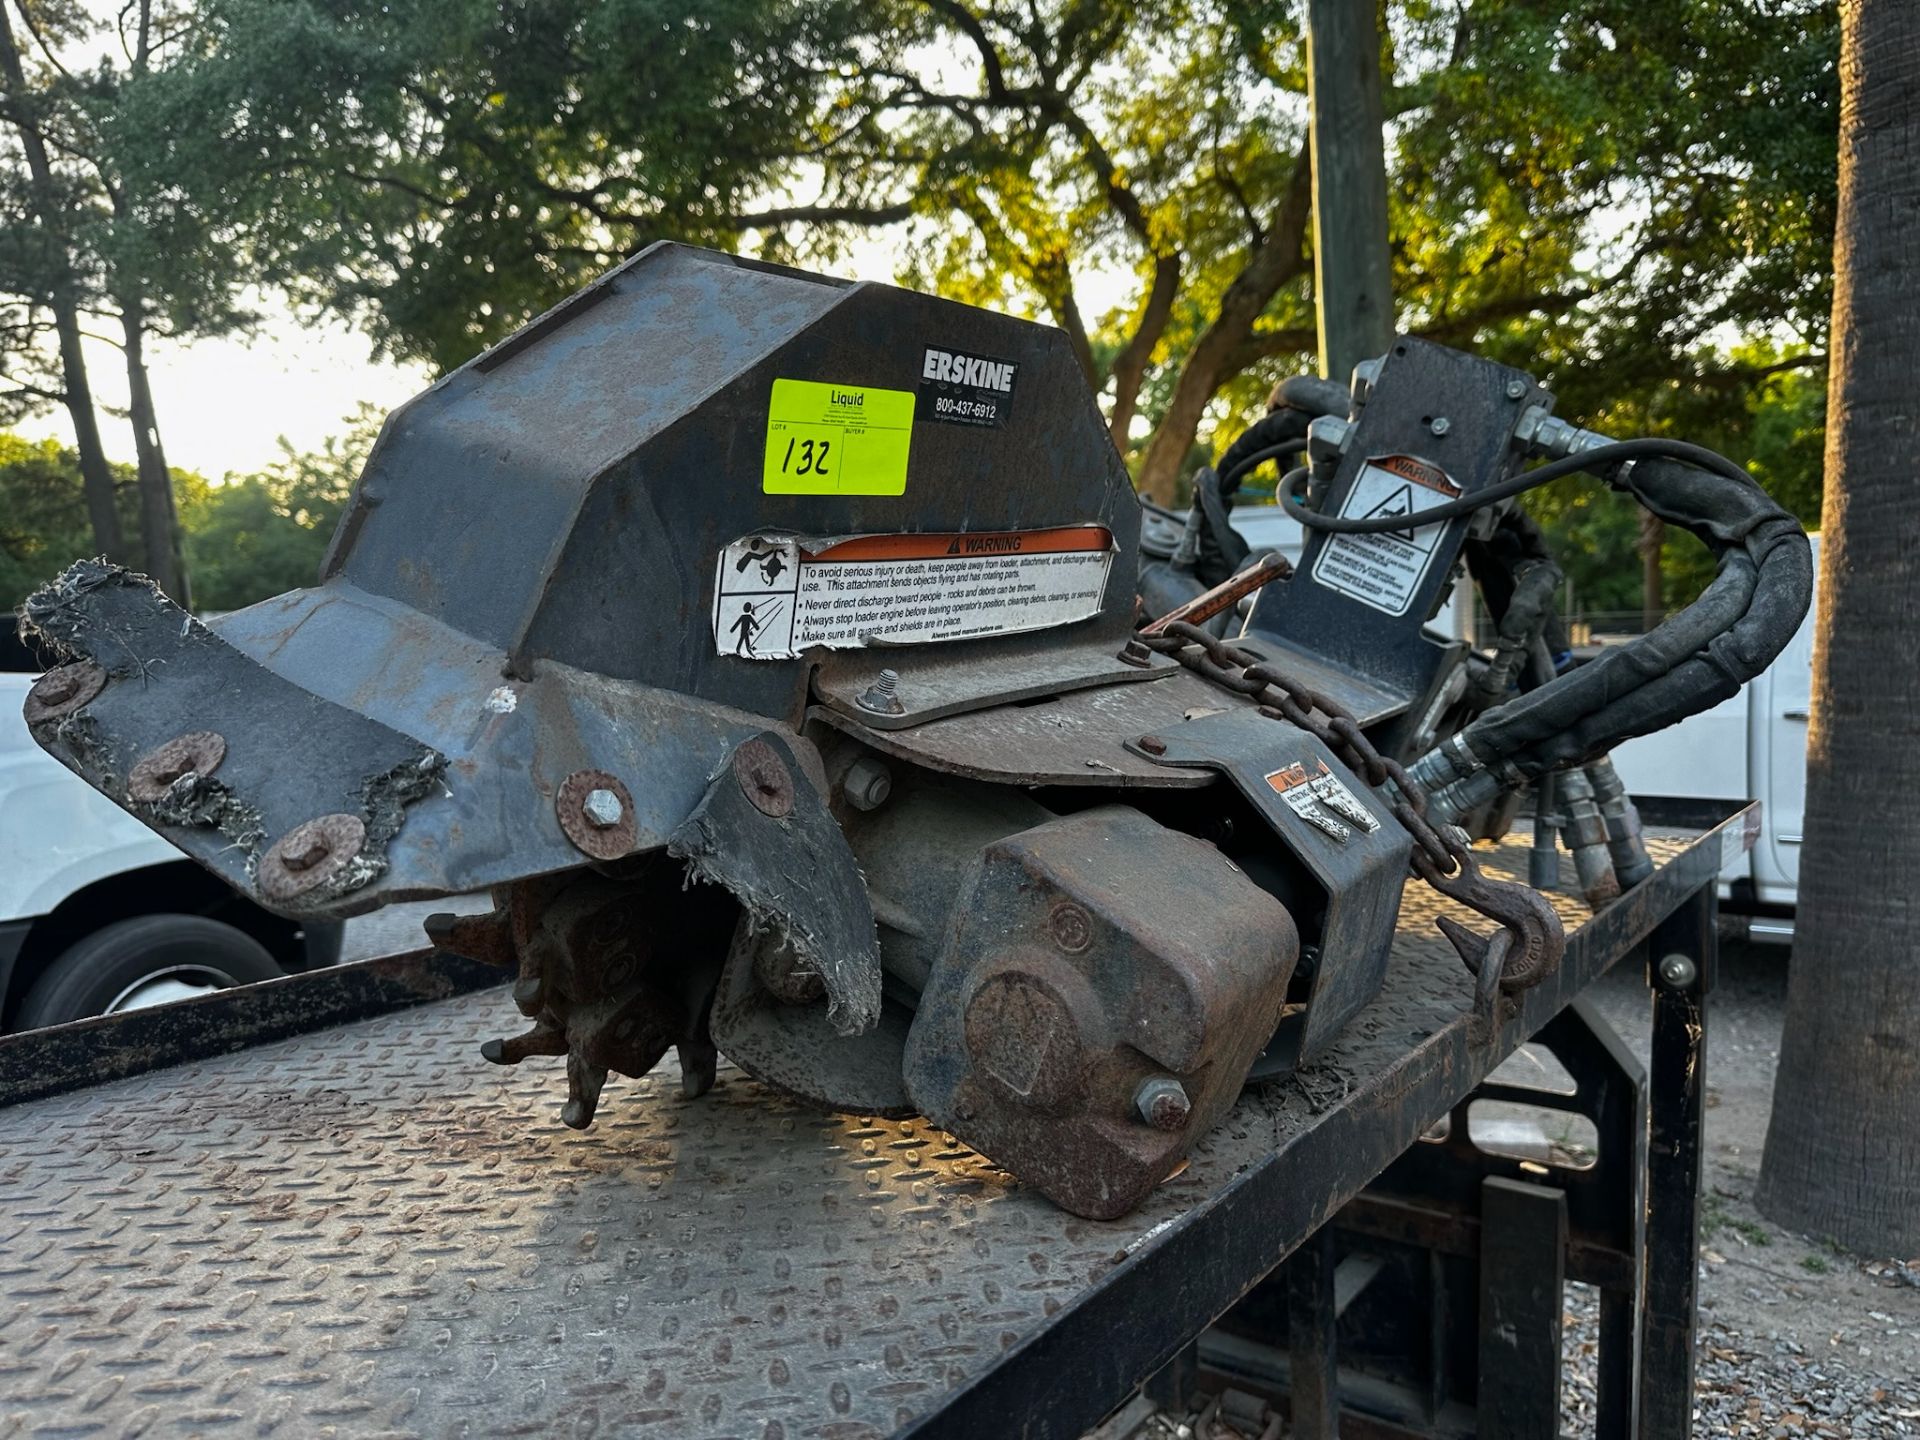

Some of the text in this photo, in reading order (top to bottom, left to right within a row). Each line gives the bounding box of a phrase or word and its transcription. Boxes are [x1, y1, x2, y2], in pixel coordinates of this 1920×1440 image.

[923, 349, 1015, 392] ERSKINE
[831, 389, 864, 408] Liquid
[936, 397, 996, 419] 800-437-6912
[782, 437, 830, 475] 132
[965, 536, 1022, 553] WARNING
[804, 566, 817, 578] To
[818, 566, 842, 578] avoid
[843, 566, 873, 577] serious
[874, 565, 894, 577] injury
[896, 566, 904, 574] or
[928, 562, 944, 574] keep
[945, 561, 967, 573] people
[968, 562, 985, 571] away
[985, 559, 998, 568] from
[802, 582, 821, 592] use.
[827, 579, 845, 591] This
[846, 578, 890, 590] attachment
[890, 576, 912, 587] sends
[913, 575, 937, 588] objects
[938, 573, 956, 586] flying
[956, 573, 969, 582] and
[970, 572, 981, 581] has
[982, 570, 1004, 581] rotating
[805, 599, 832, 610] Never
[833, 597, 856, 608] direct
[857, 595, 893, 608] discharge
[895, 593, 919, 604] toward
[919, 591, 942, 603] people
[947, 588, 964, 599] rocks
[965, 587, 978, 597] and
[978, 585, 996, 596] debris
[997, 586, 1008, 594] can
[1008, 584, 1016, 593] be
[802, 615, 834, 628] Always
[835, 614, 853, 625] stop
[855, 611, 879, 623] loader
[879, 609, 904, 621] engine
[905, 606, 927, 617] before
[928, 604, 951, 615] leaving
[952, 601, 982, 614] operator's
[982, 598, 1006, 611] position,
[801, 630, 826, 642] Make
[827, 631, 845, 639] sure
[846, 627, 857, 637] all
[857, 625, 883, 639] guards
[884, 623, 899, 634] and
[899, 621, 923, 632] shields
[924, 620, 936, 629] are
[936, 618, 943, 627] in
